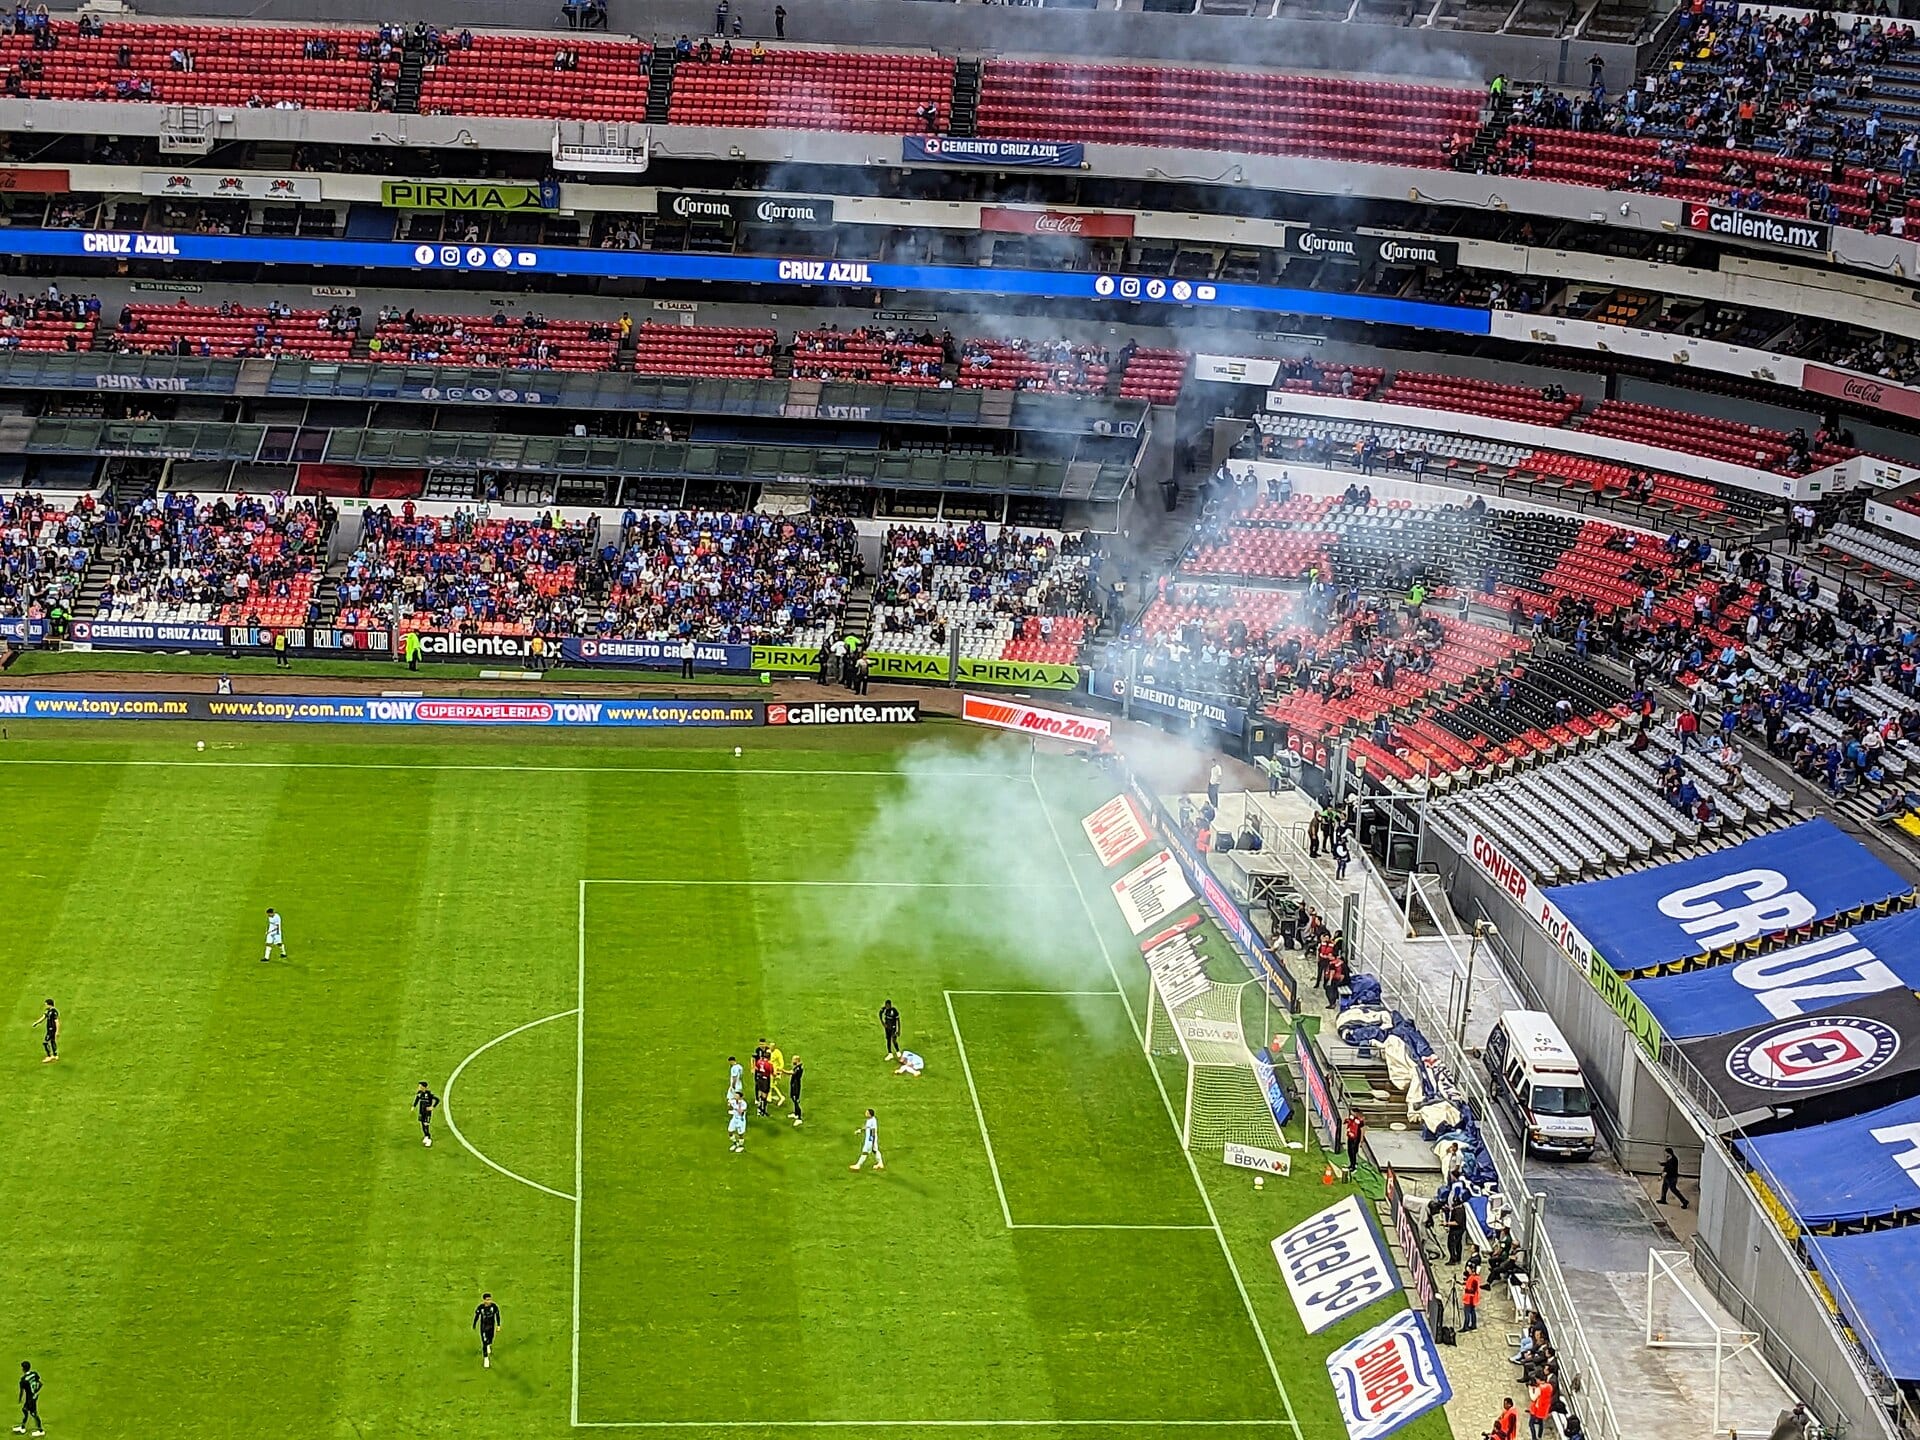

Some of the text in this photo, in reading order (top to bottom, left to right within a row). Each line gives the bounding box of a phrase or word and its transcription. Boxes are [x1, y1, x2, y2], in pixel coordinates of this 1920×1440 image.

[941, 139, 1059, 158] CEMENTO CRUZ AZUL
[390, 185, 506, 208] PIRMA
[673, 196, 733, 218] Corona
[757, 200, 817, 223] Corona
[1709, 210, 1820, 250] caliente.mx
[83, 233, 180, 255] CRUZ AZUL
[1298, 230, 1356, 256] Corona
[1380, 239, 1440, 264] Corona
[778, 261, 873, 283] CRUZ AZUL
[667, 302, 693, 311] SALIDA
[91, 625, 223, 642] CEMENTO CRUZ AZUL
[600, 641, 660, 657] CEMENTO
[696, 644, 728, 661] AZUL
[866, 656, 941, 675] PIRMA
[972, 663, 1049, 683] PIRMA
[35, 699, 188, 716] www.tony.com.mx
[209, 701, 364, 719] www.tony.com.mx
[367, 701, 416, 720] TONY
[420, 705, 550, 719] SUPERPAPELERIAS
[553, 703, 603, 722] TONY
[607, 706, 754, 724] www.tony.com.mx
[787, 703, 916, 724] caliente.mx
[1132, 685, 1175, 707] EMENTO
[1203, 705, 1227, 723] AZUL
[1473, 833, 1528, 904] GONHER
[1128, 867, 1168, 923] Koblenz
[1657, 868, 1906, 1021] CRUZ
[1591, 955, 1639, 1033] PIRMA
[1188, 1028, 1221, 1039] BBVA
[1225, 1145, 1245, 1155] LIGA
[1234, 1153, 1270, 1169] BBVA
[1280, 1208, 1371, 1286] telcel
[1305, 1266, 1382, 1312] 5G
[1354, 1337, 1415, 1415] BIMBO
